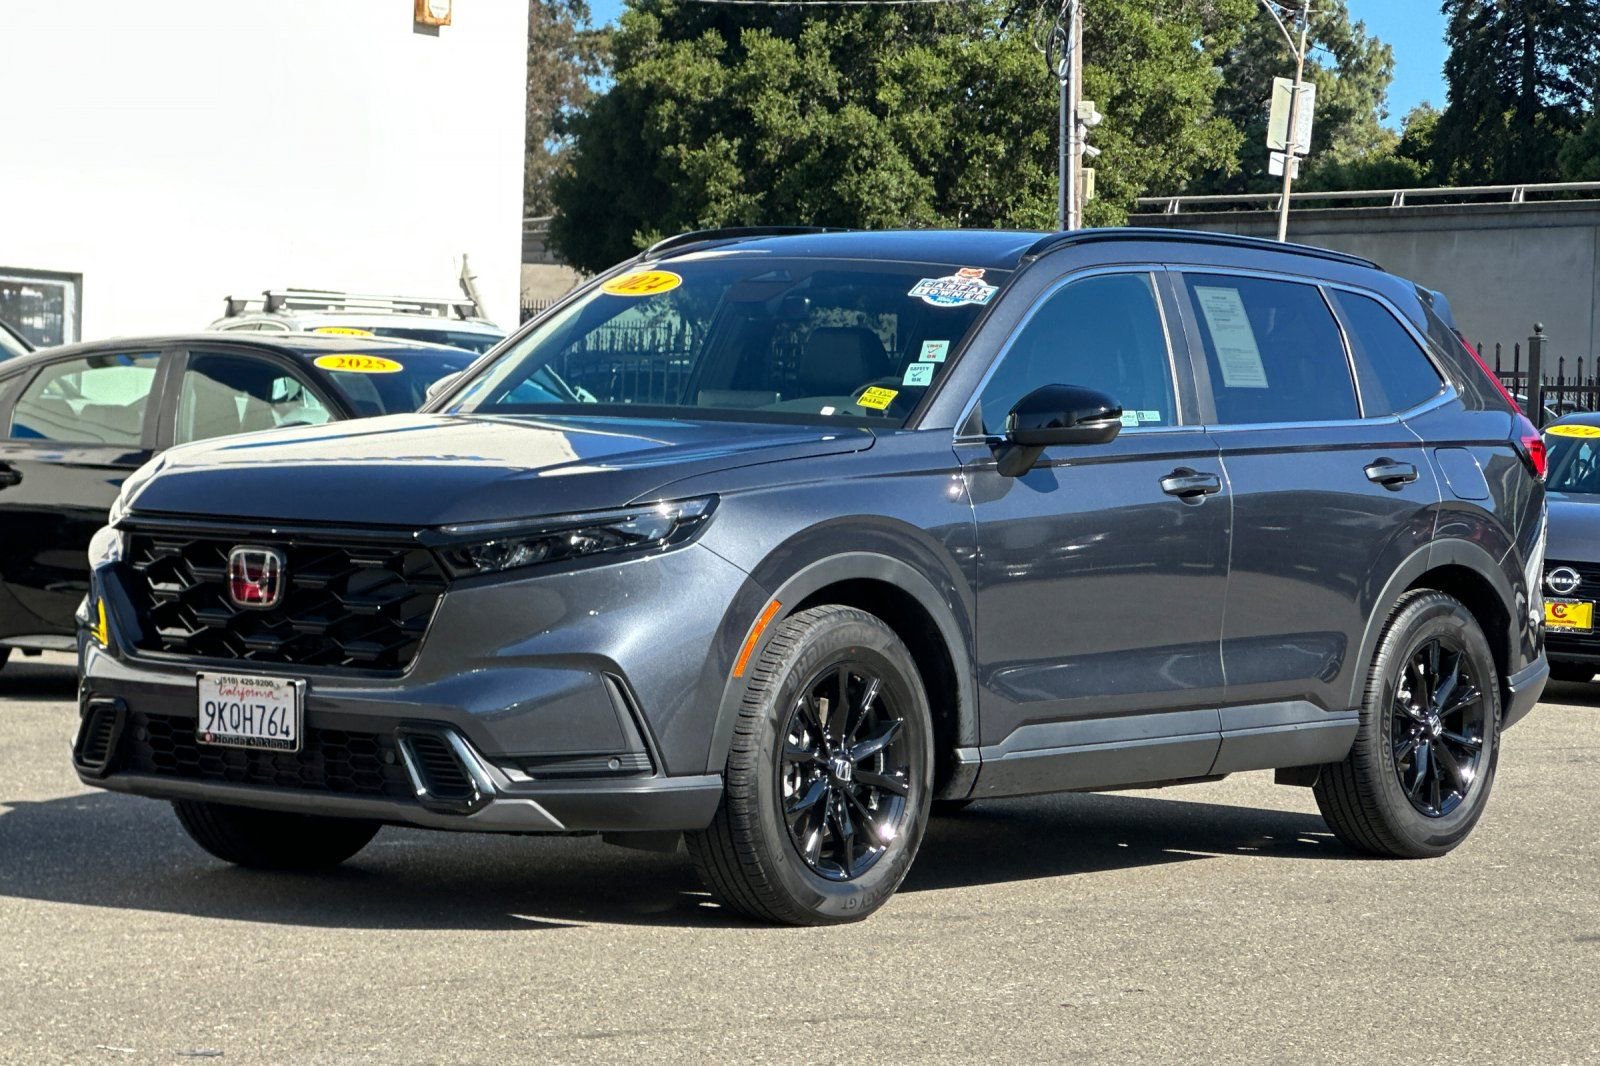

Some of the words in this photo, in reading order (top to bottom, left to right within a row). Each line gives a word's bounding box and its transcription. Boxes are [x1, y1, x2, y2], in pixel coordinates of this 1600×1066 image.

[921, 281, 990, 295] CARFAX
[336, 358, 386, 369] 2025
[1545, 577, 1580, 585] NISSAN
[218, 684, 280, 701] California
[205, 701, 290, 737] 9KQH764
[216, 733, 246, 746] Honda
